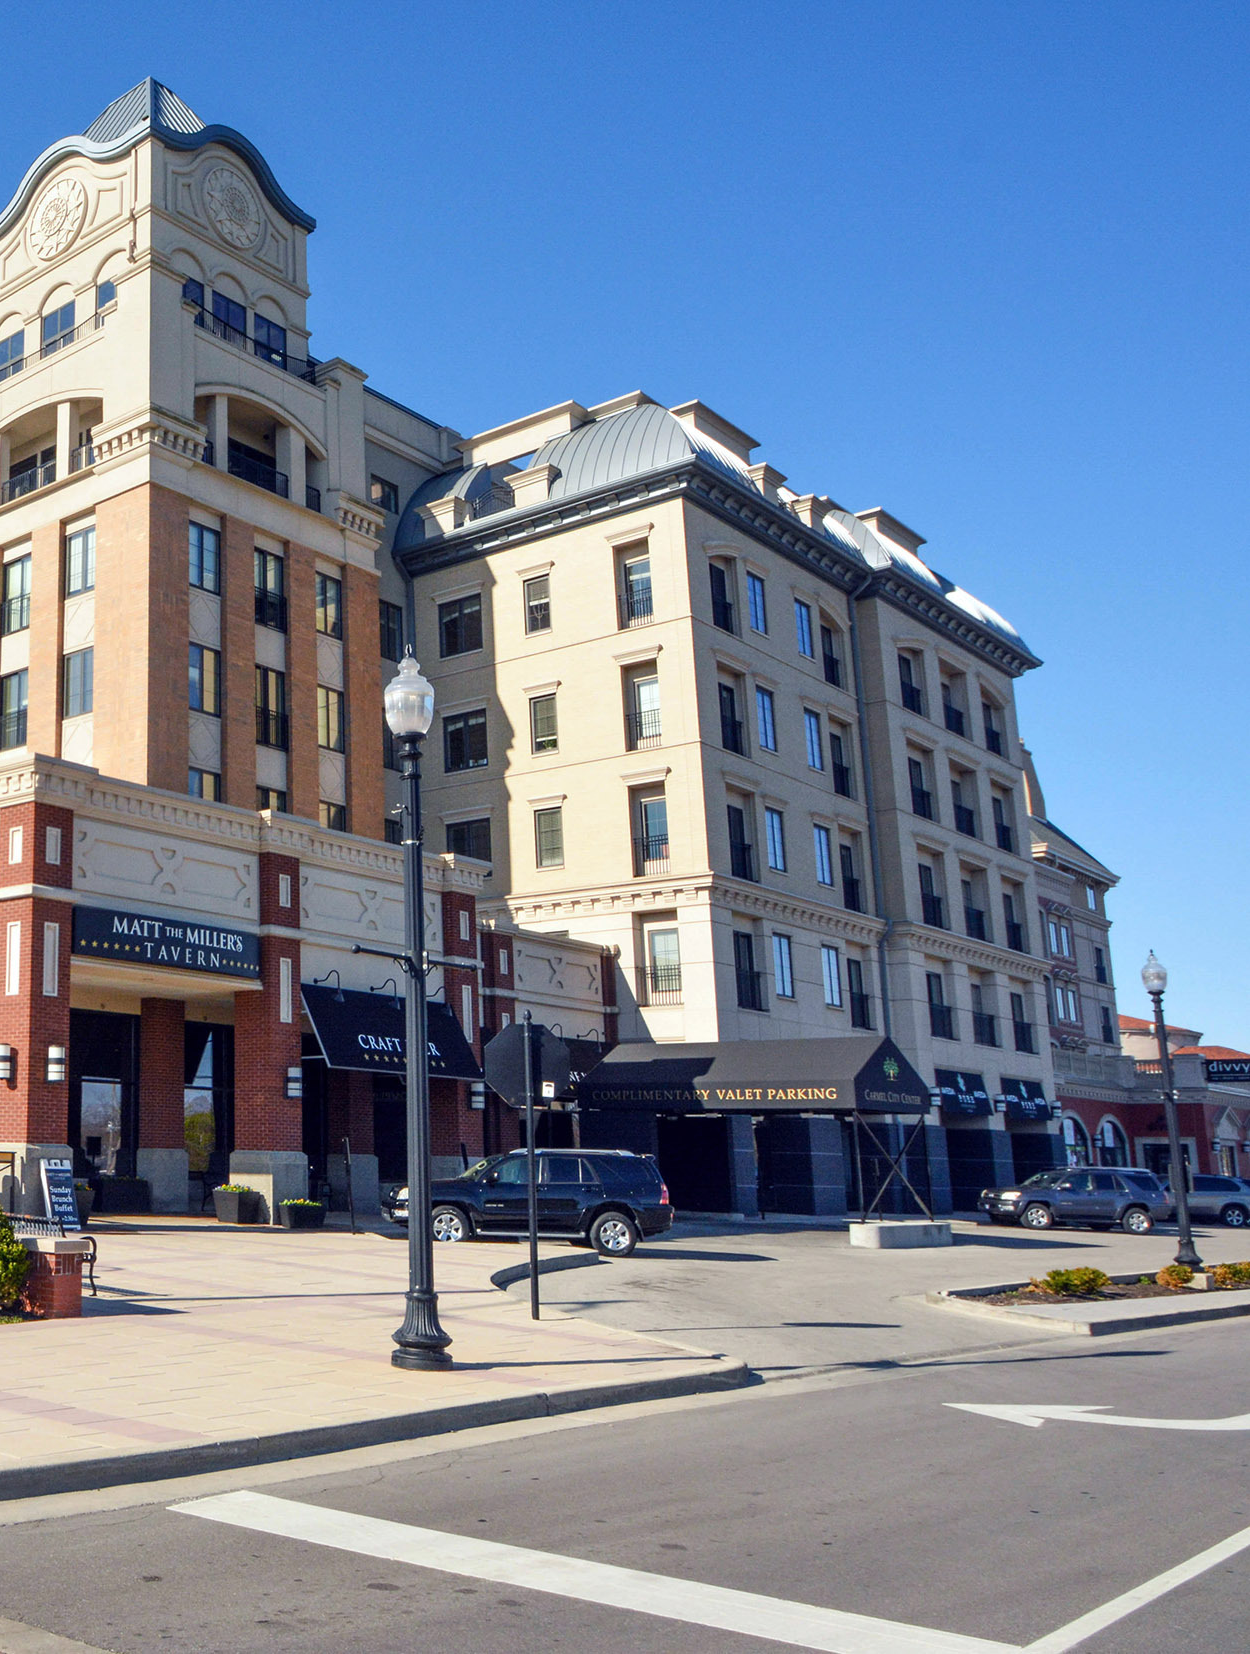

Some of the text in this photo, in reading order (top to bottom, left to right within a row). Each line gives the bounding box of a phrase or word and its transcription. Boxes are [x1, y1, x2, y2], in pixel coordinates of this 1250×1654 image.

[112, 916, 243, 953] MATT THE MILLER'S
[144, 942, 221, 968] TAVERN
[358, 1034, 402, 1052] CRAFT
[1208, 1061, 1250, 1074] divvy
[592, 1088, 838, 1101] COMPLIMENTARY VALET PARKING
[49, 1185, 72, 1196] Sunday
[51, 1195, 73, 1203] Brunch
[54, 1204, 73, 1212] Buffet
